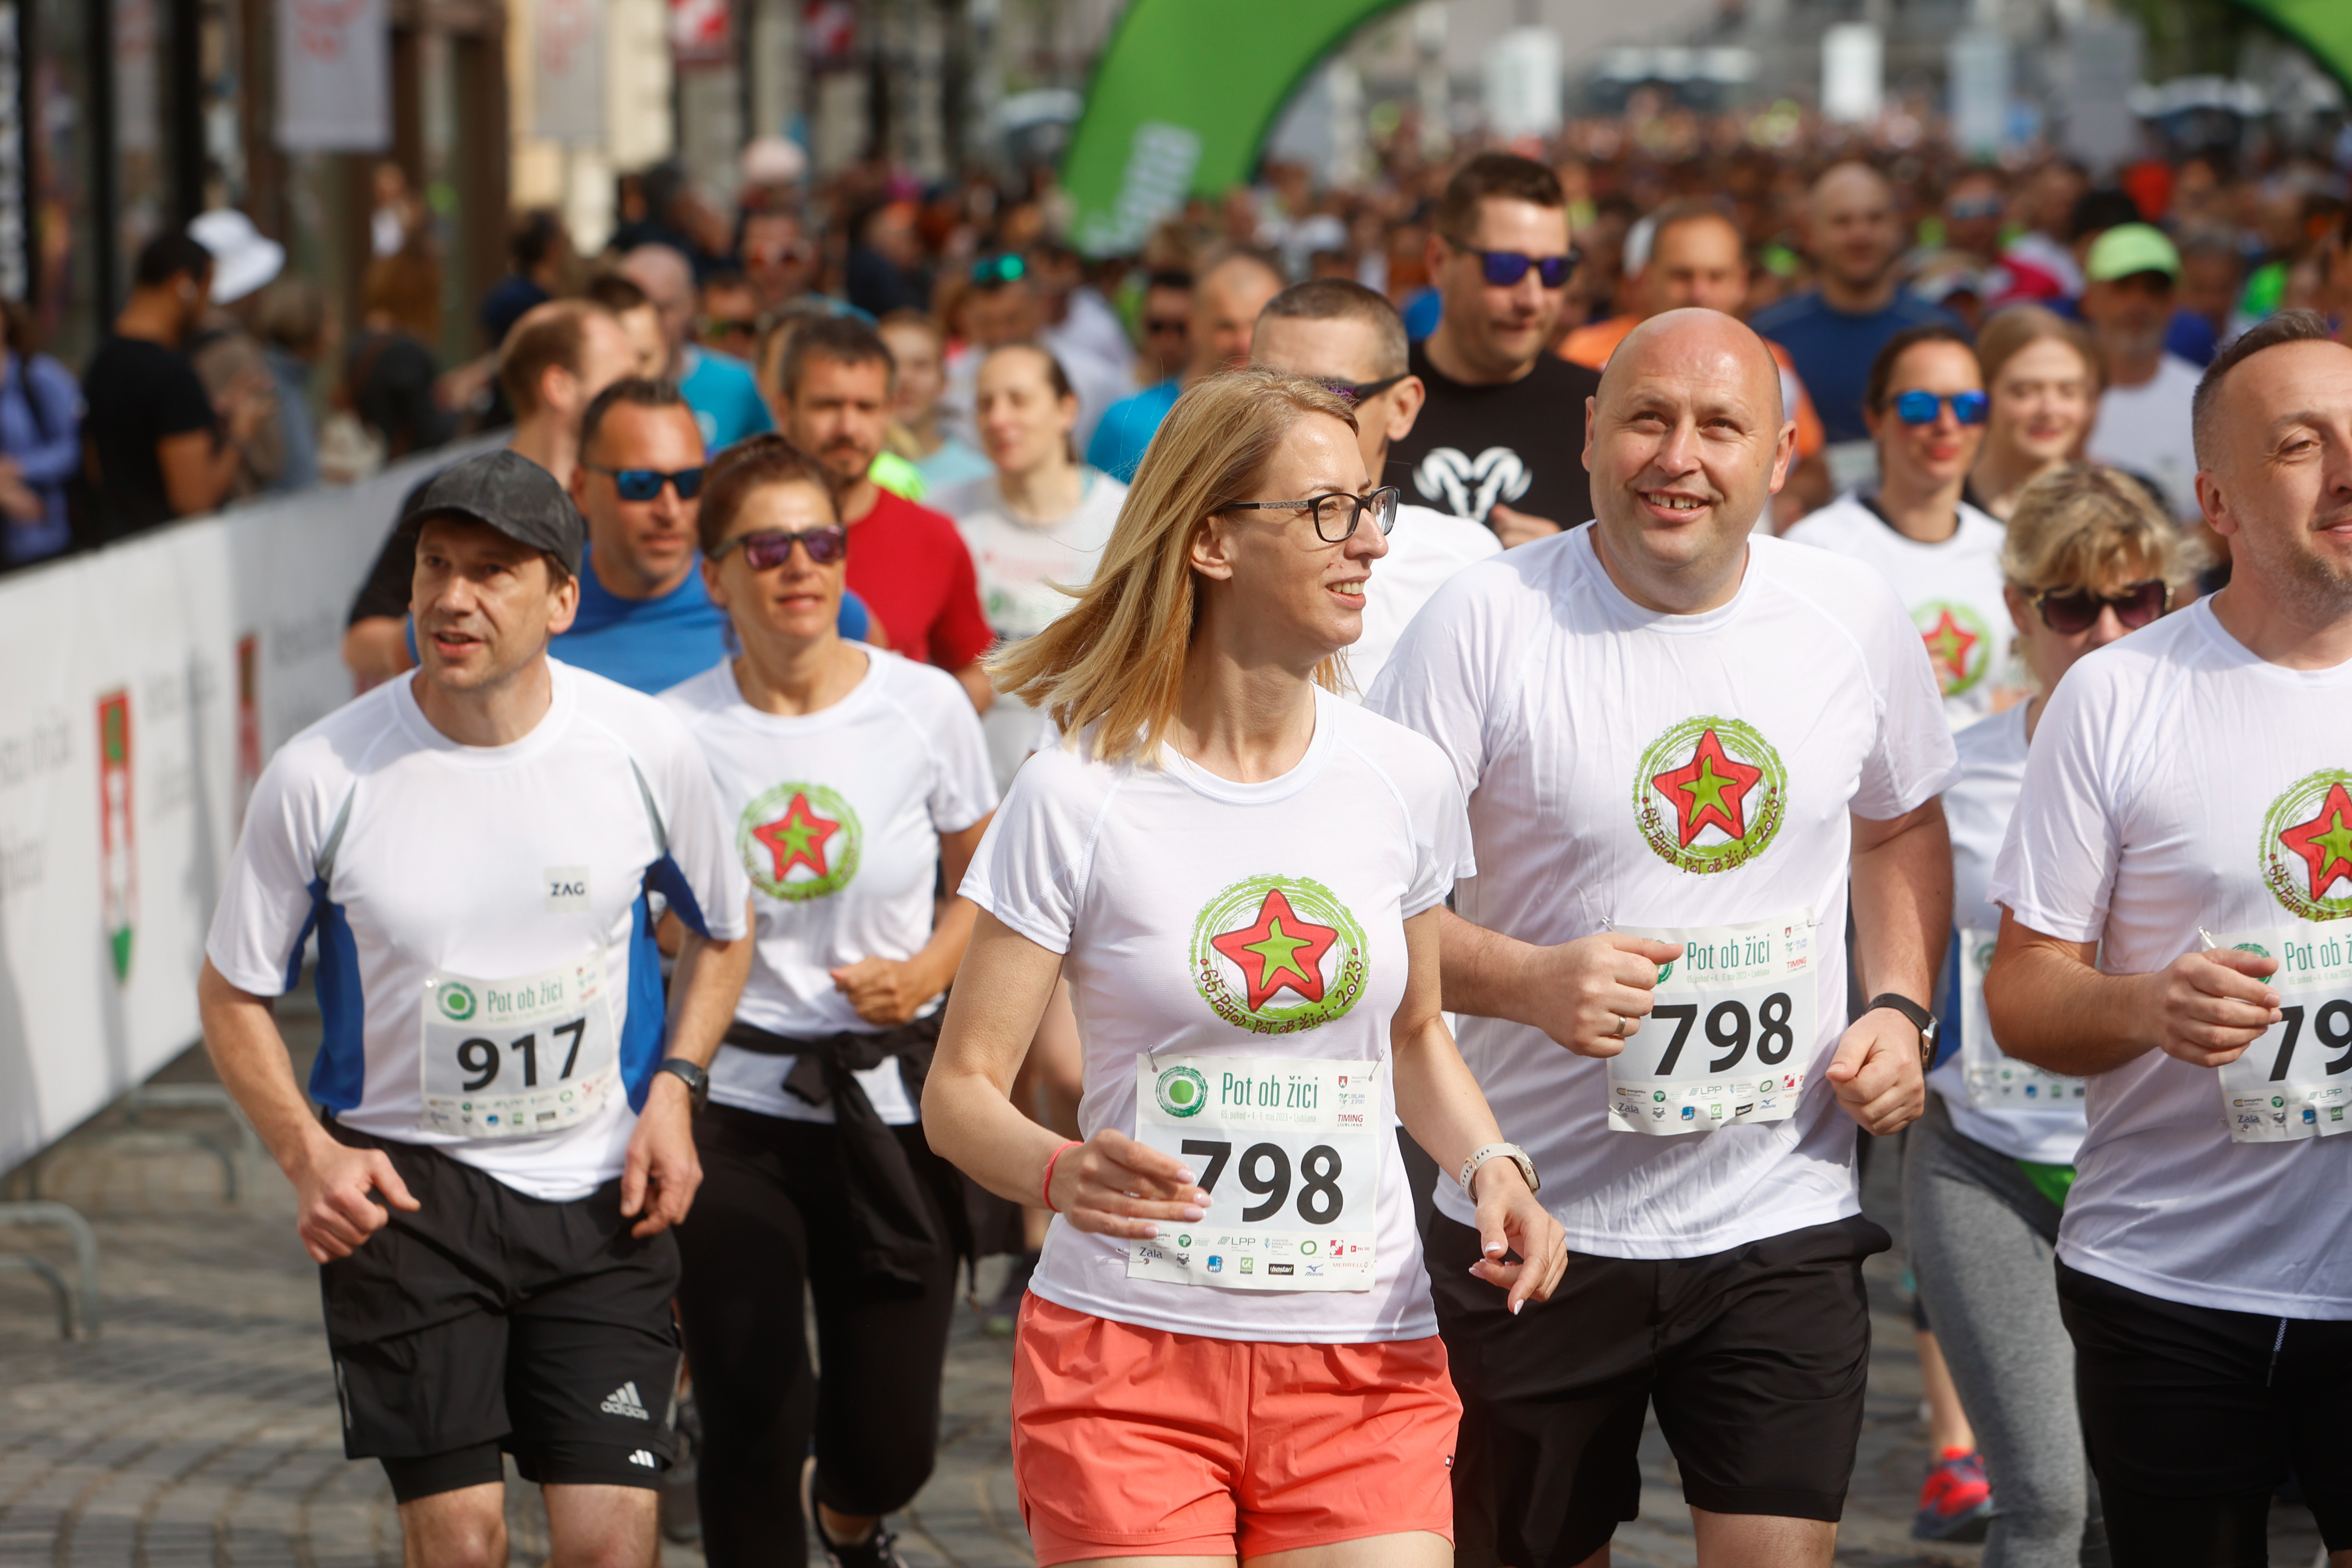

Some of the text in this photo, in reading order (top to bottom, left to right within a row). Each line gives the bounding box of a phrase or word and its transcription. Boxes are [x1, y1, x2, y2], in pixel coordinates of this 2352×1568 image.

[1755, 799, 1779, 842] 2023
[550, 882, 585, 896] ZAG
[1687, 942, 1714, 971] Pot
[1721, 939, 1739, 969] ob
[1745, 933, 1770, 965] žici
[2285, 941, 2315, 971] Pot
[2320, 936, 2340, 967] ob
[1336, 961, 1362, 1006] 2023
[487, 989, 512, 1013] Pot
[517, 985, 536, 1010] ob
[540, 976, 564, 1006] žici
[1651, 992, 1793, 1075] 798
[457, 1017, 586, 1092] 917
[1222, 1073, 1318, 1109] Pot ob žici
[1701, 1086, 1722, 1095] LPP
[2319, 1088, 2343, 1099] LPP
[1230, 1111, 1246, 1120] pohod
[1265, 1113, 1275, 1122] maj
[1276, 1113, 1288, 1121] 2023
[1294, 1113, 1316, 1124] Ljubljana
[1618, 1103, 1639, 1113] Zala
[1338, 1114, 1363, 1123] TIMING
[2238, 1115, 2260, 1123] Zala
[1181, 1139, 1344, 1225] 798
[1231, 1237, 1256, 1246] LPP
[1139, 1246, 1163, 1259] Zala
[600, 1401, 650, 1420] adidas
